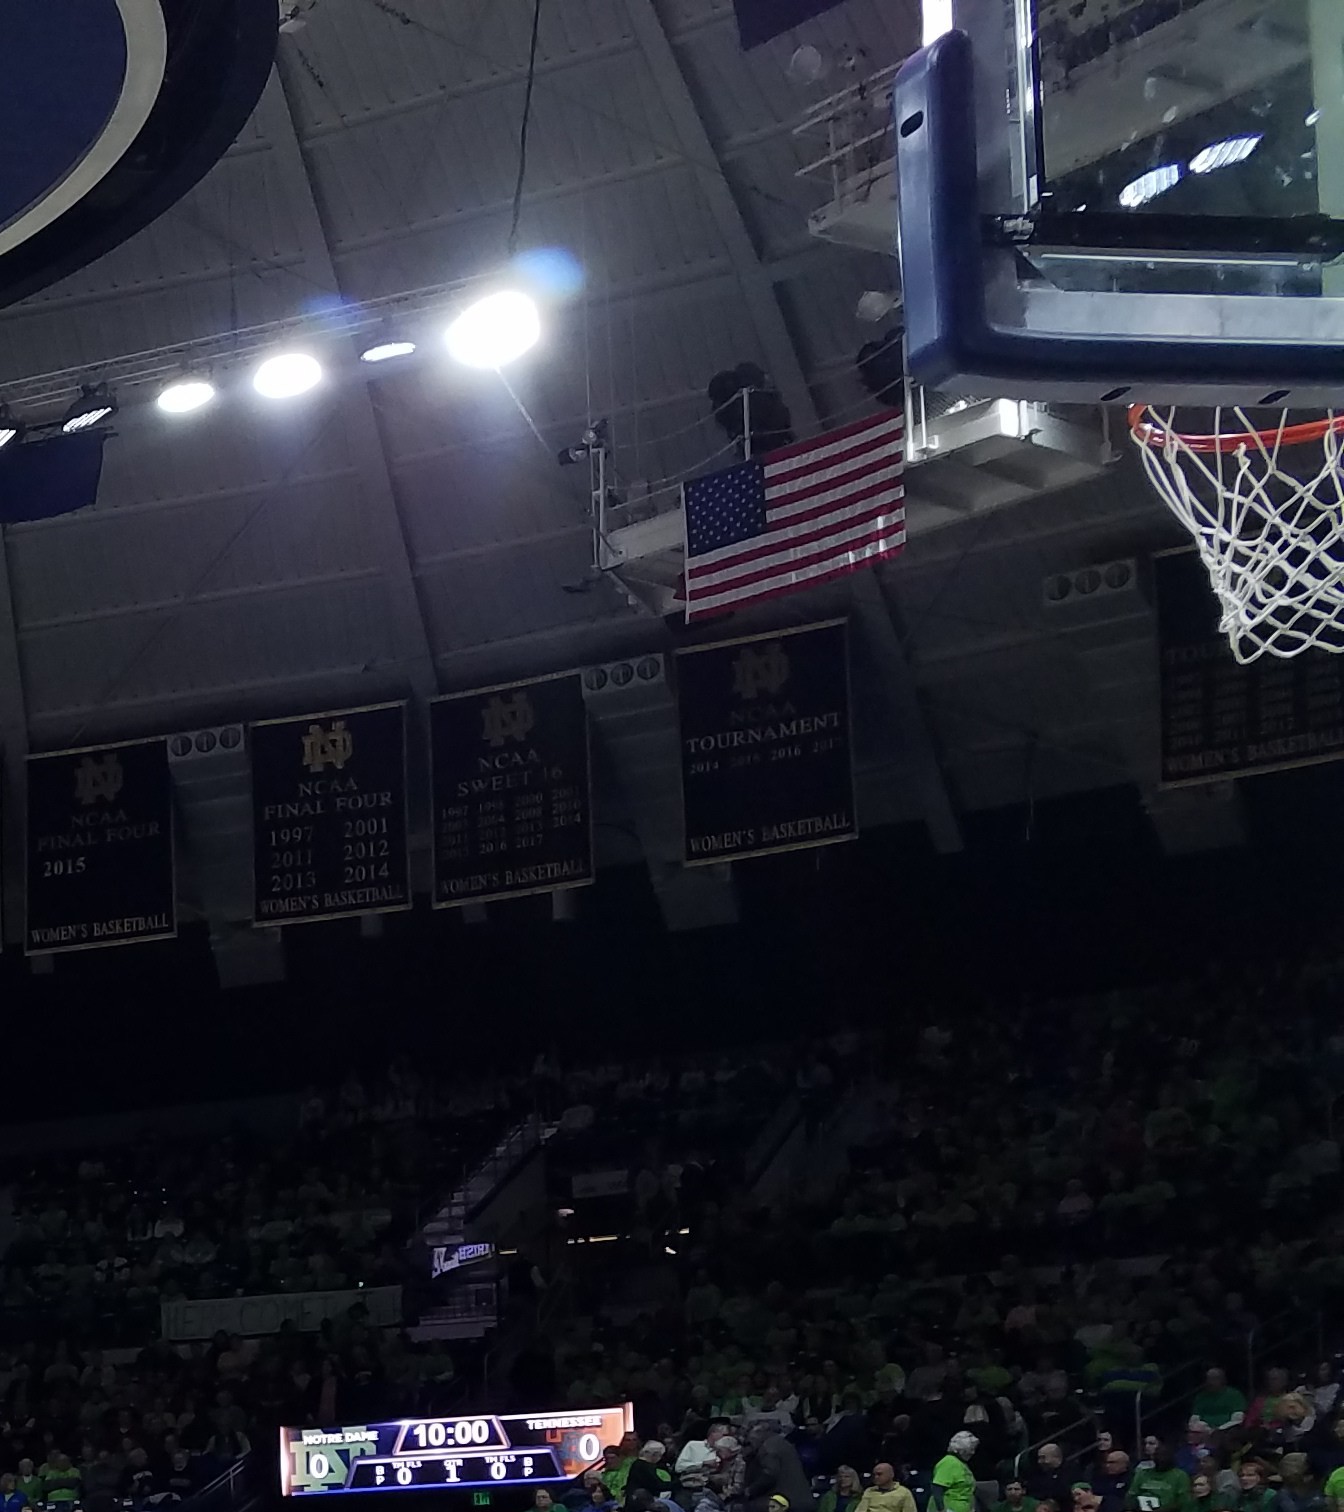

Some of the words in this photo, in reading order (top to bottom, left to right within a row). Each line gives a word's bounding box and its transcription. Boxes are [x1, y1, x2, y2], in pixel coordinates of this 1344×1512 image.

[686, 713, 840, 753] TOURNAMENT
[478, 748, 541, 772] NCAA
[770, 746, 801, 761] 2016
[299, 777, 359, 797] NCAA
[264, 800, 327, 820] FINAL
[335, 791, 393, 812] FOUR
[71, 809, 128, 829] NCAA
[270, 826, 313, 846] 1997
[344, 817, 389, 838] 2001
[762, 813, 851, 842] BASKETBALL
[38, 831, 98, 852] FINAL
[106, 821, 160, 842] FOUR
[272, 849, 312, 869] 2011
[344, 839, 389, 861] 2012
[43, 857, 87, 878] 2015
[344, 862, 389, 884] 2014
[505, 859, 584, 885] BASKETBALL
[259, 895, 320, 914] WOMEN'S
[324, 884, 404, 908] BASKETBALL
[31, 923, 89, 943] WOMEN'S
[93, 913, 169, 937] BASKETBALL
[413, 1420, 490, 1447] 10:00
[526, 1416, 602, 1431] TENNESSEE
[302, 1433, 344, 1445] NOTRE
[345, 1430, 379, 1442] DAME
[579, 1433, 600, 1461] 0
[311, 1454, 329, 1480] 0
[397, 1467, 412, 1486] 0
[445, 1465, 461, 1483] 1
[491, 1462, 506, 1480] 0
